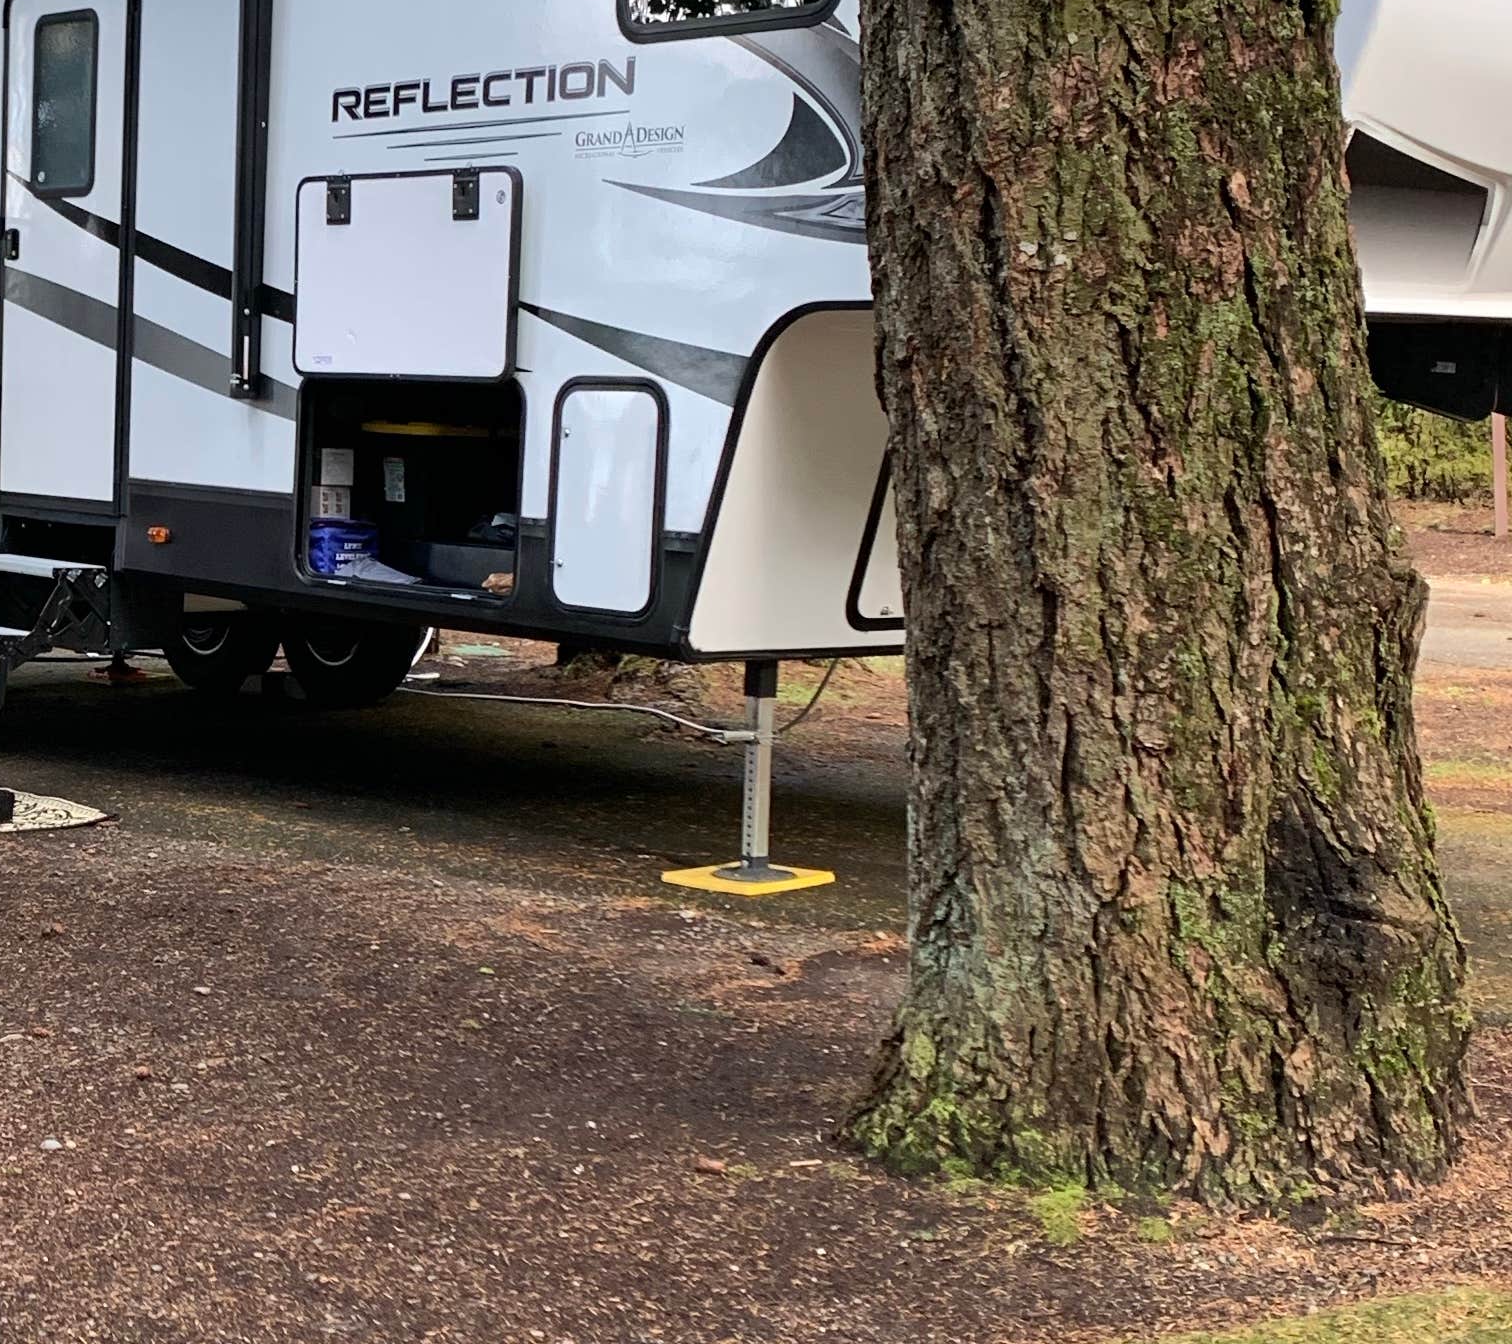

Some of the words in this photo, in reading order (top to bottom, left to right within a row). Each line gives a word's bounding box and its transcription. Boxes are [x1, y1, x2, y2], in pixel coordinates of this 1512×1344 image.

[331, 56, 637, 123] REFLECTION
[575, 131, 623, 147] GRAND
[636, 126, 686, 143] DESIGN
